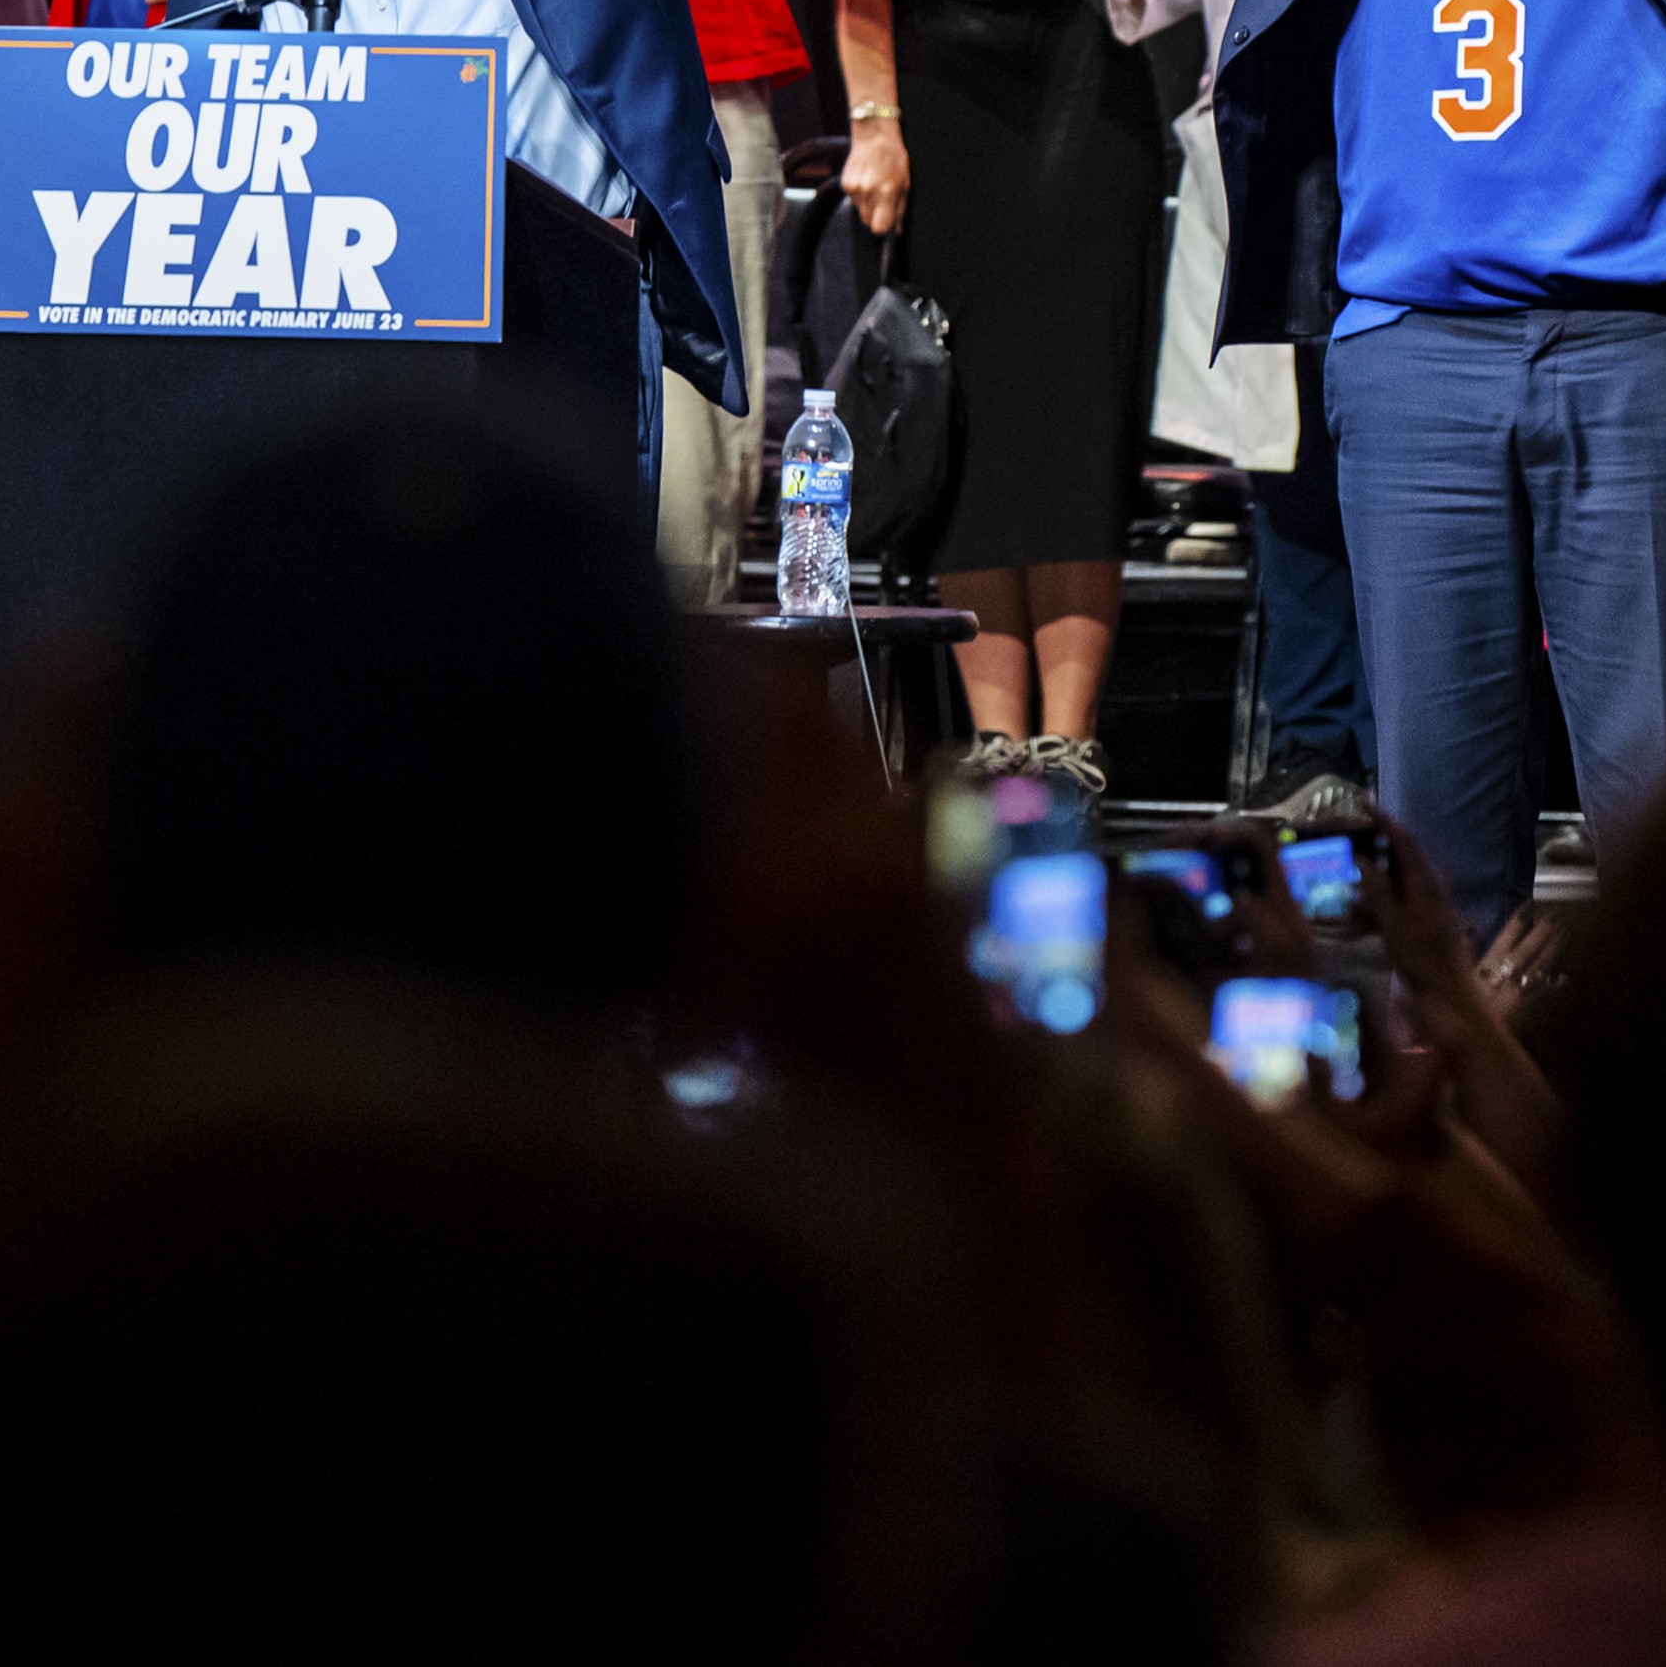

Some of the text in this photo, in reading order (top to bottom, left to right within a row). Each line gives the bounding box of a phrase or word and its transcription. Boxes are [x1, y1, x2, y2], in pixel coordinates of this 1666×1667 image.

[66, 41, 367, 102] OUR TEAM
[126, 99, 318, 194] OUR
[32, 190, 398, 311] YEAR
[39, 306, 403, 330] VOTE IN THE DEMOCRATIC PRIMARY JUNE 23
